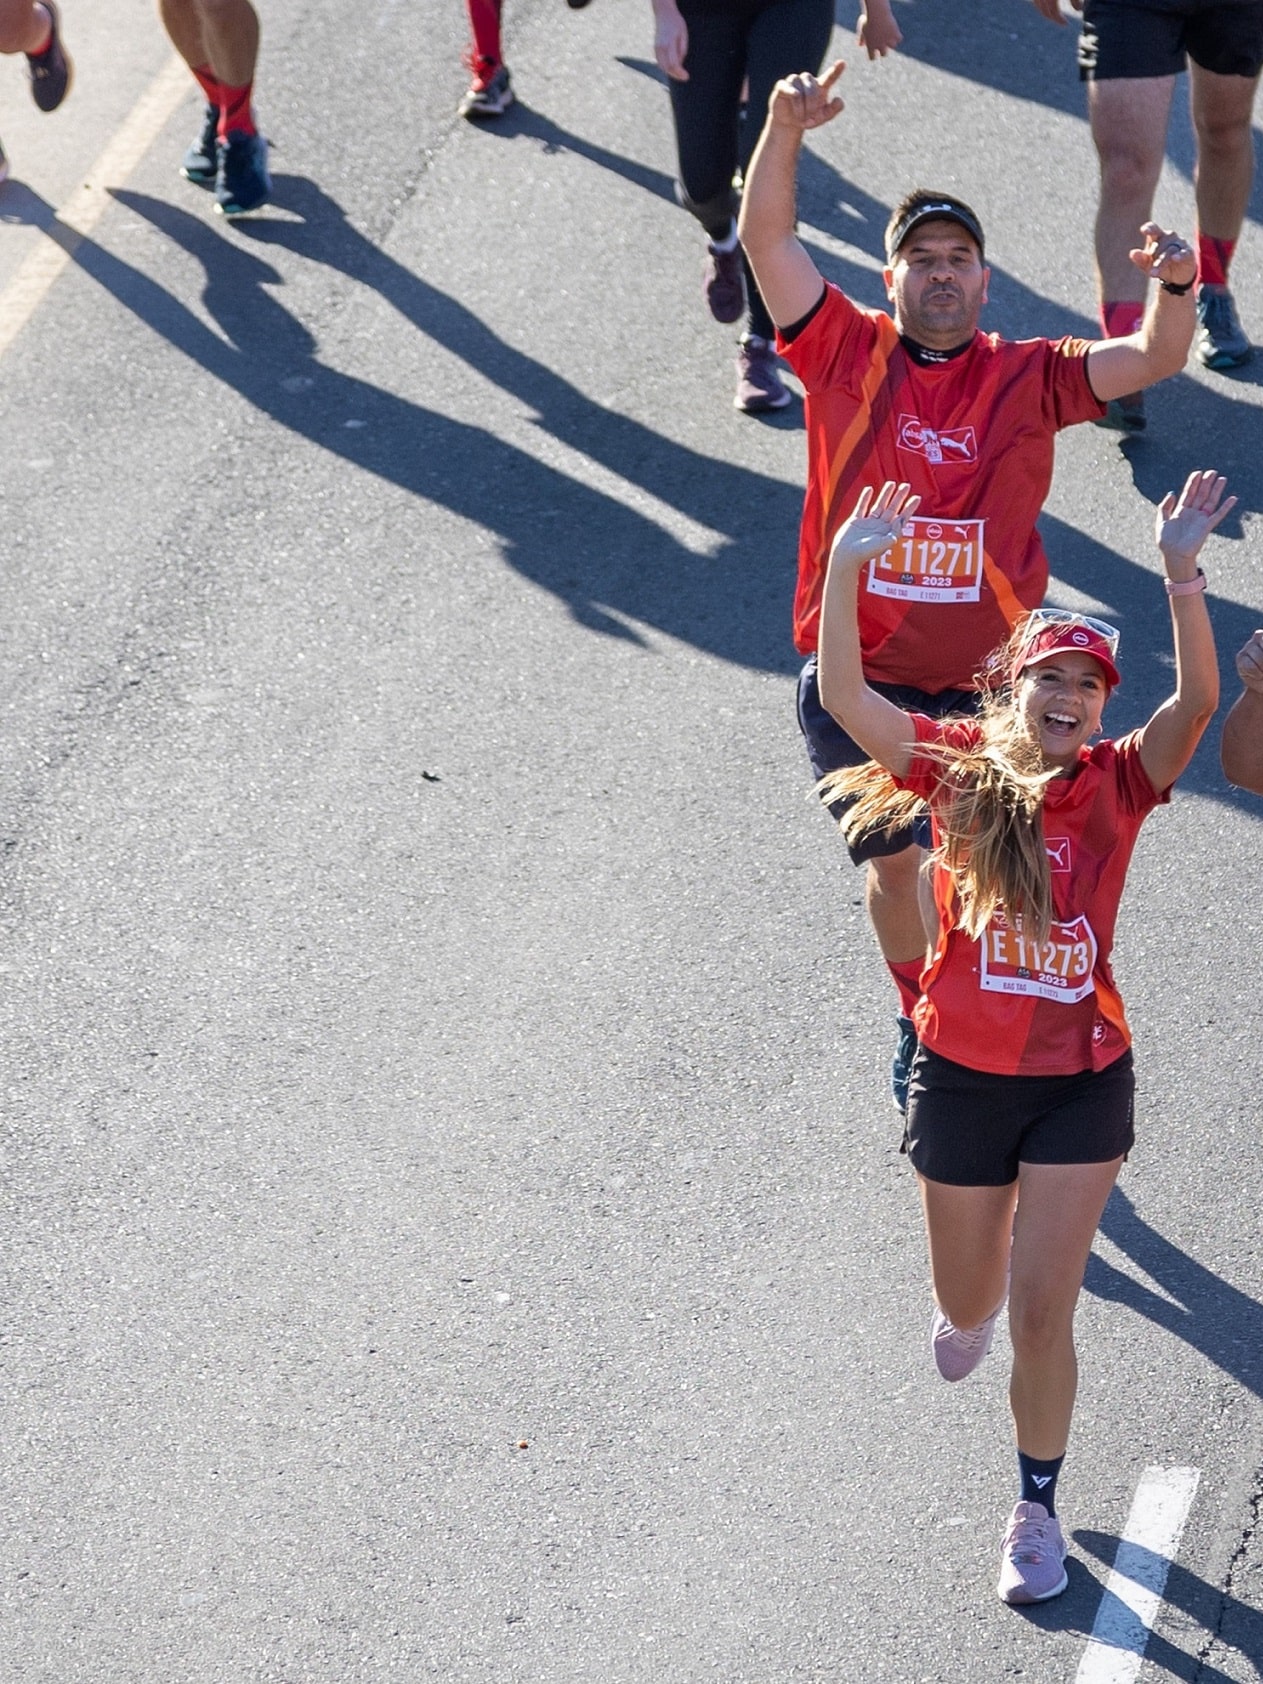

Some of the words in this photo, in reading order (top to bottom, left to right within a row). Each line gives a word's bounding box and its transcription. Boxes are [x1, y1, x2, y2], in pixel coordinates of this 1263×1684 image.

[902, 539, 973, 576] 11271
[922, 576, 952, 587] 2023
[993, 930, 1008, 963] E
[1015, 935, 1088, 976] 11273
[1003, 982, 1015, 990] BAG
[1016, 983, 1027, 991] TAG
[1039, 973, 1068, 987] 2023
